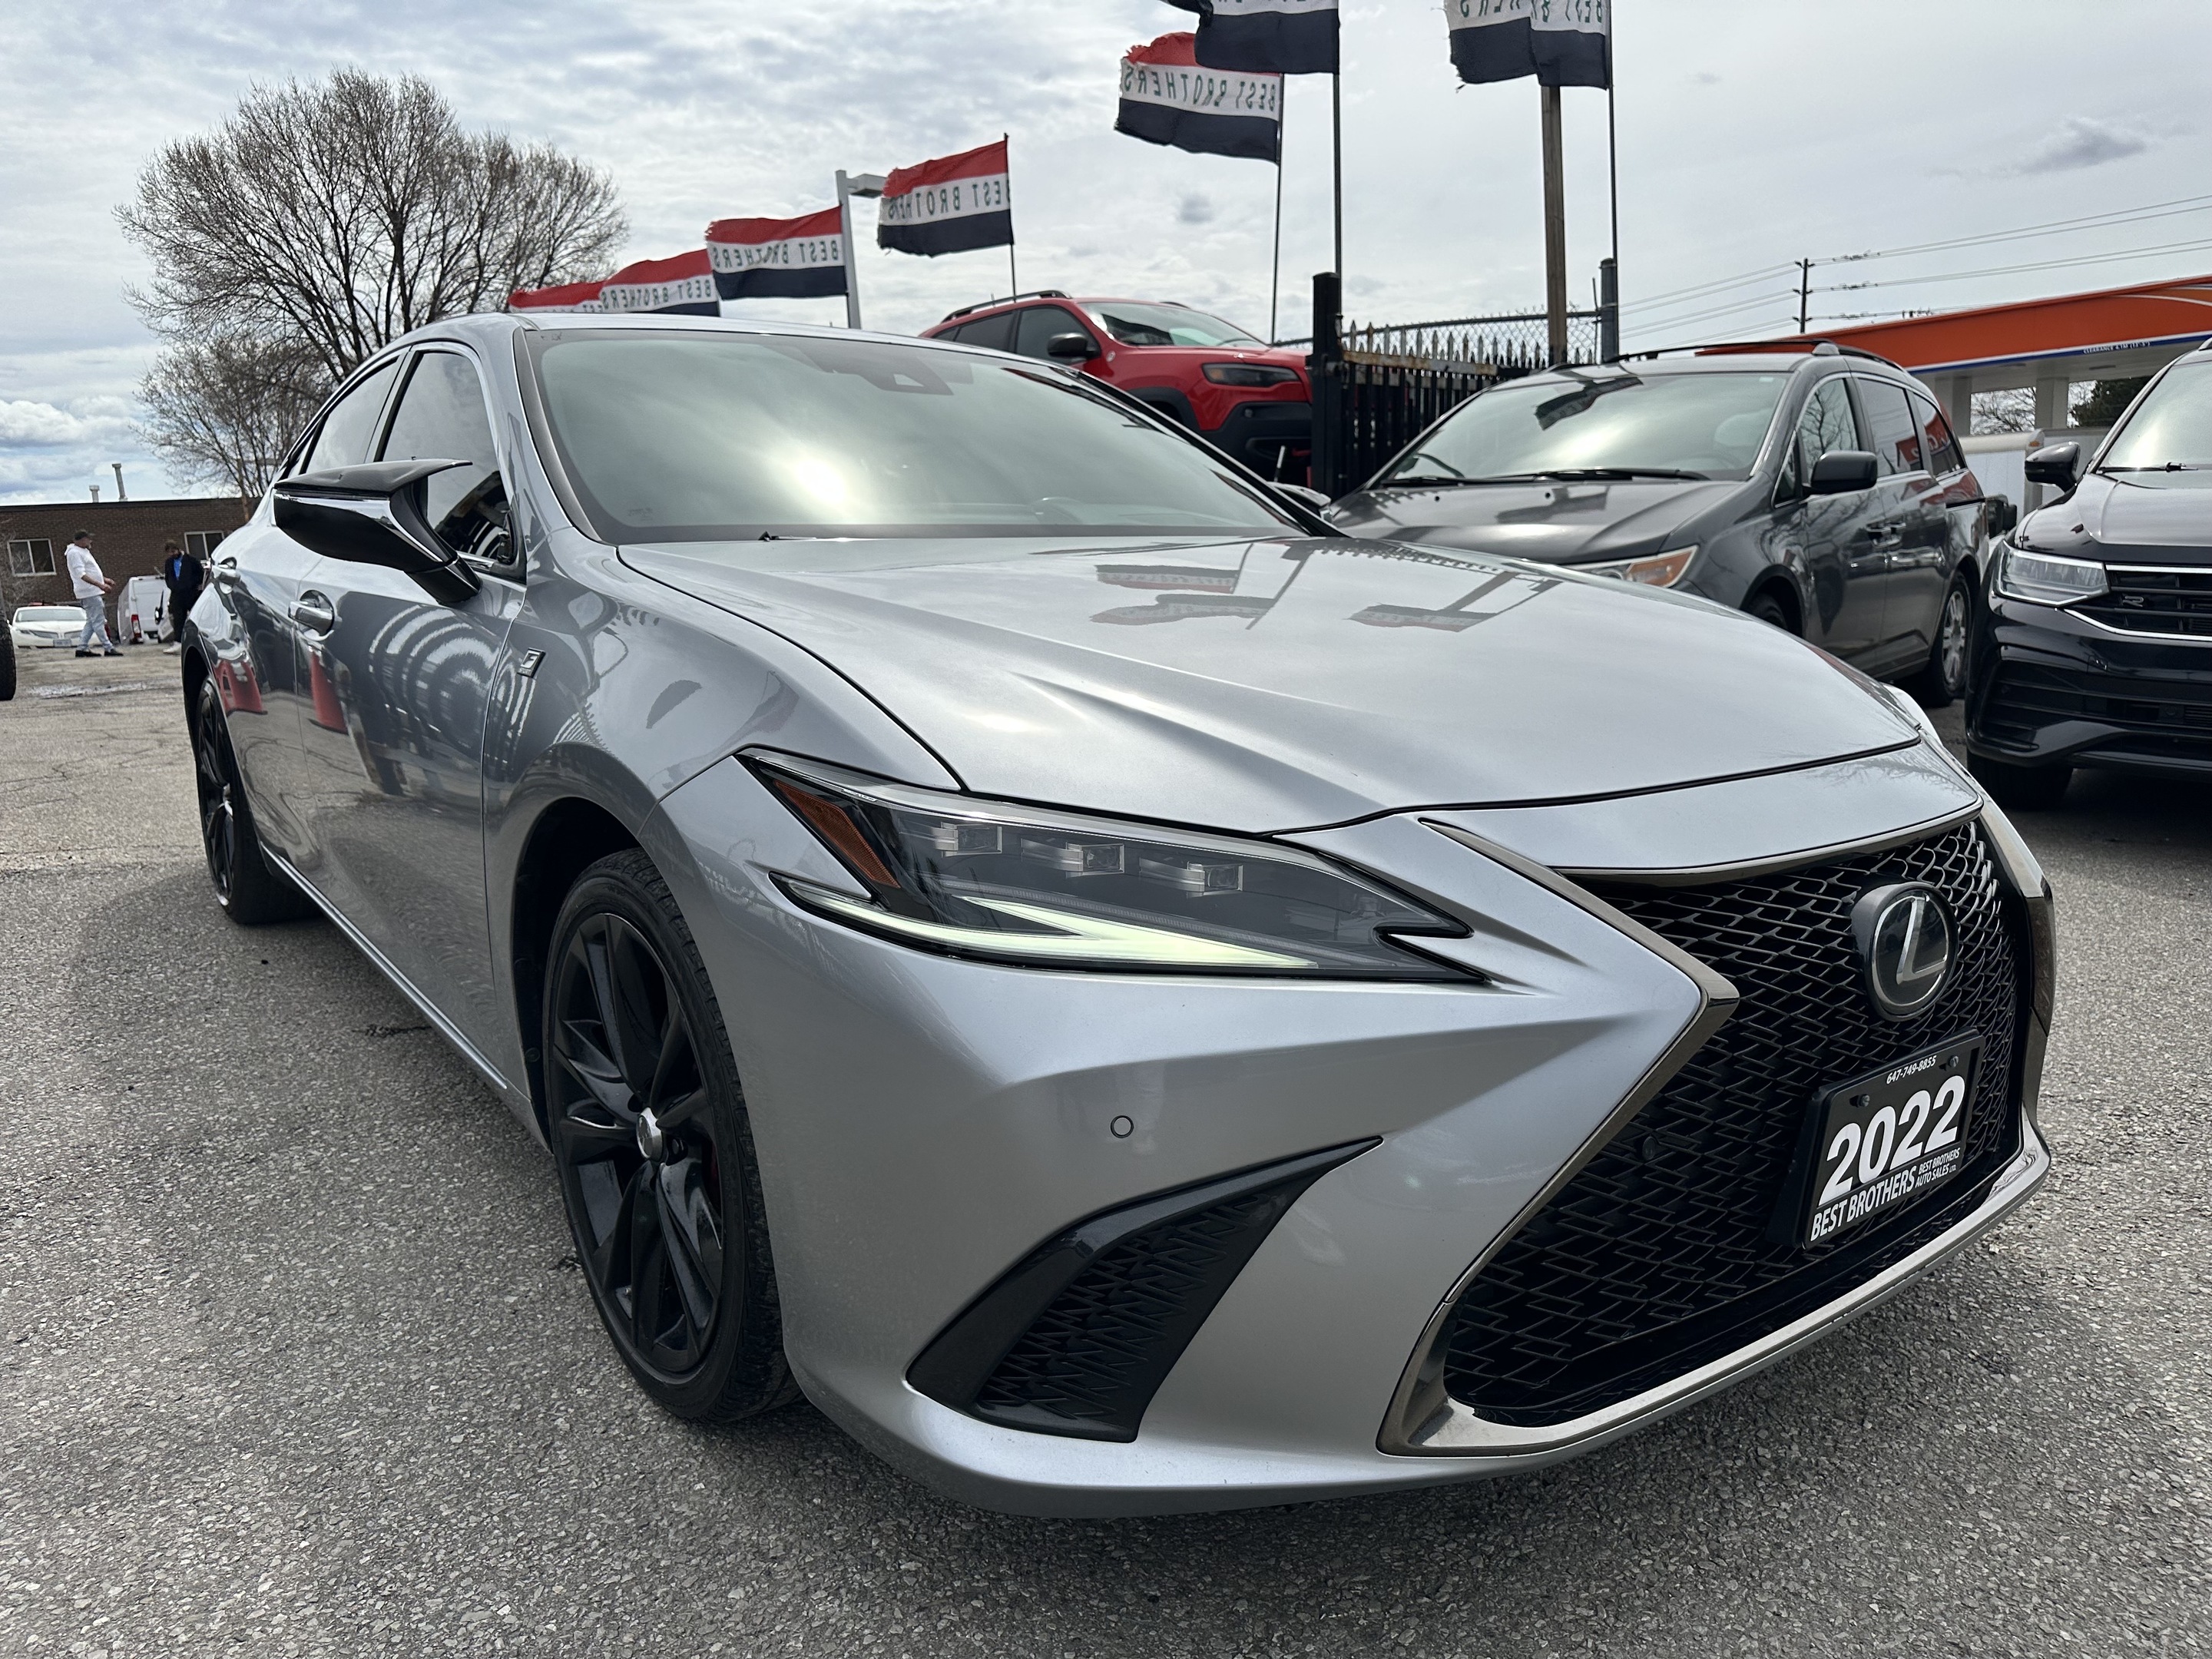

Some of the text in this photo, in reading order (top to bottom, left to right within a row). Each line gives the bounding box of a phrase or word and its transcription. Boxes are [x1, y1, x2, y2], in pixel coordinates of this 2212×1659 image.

[1886, 1055, 1937, 1084] 647-749-8855
[1818, 1075, 1965, 1207] 2022
[1915, 1171, 1932, 1189] AUTO
[1931, 1162, 1950, 1181] SALES
[1919, 1147, 1961, 1175] BEST BROTHERS
[1810, 1165, 1917, 1242] BEST BROTHERS
